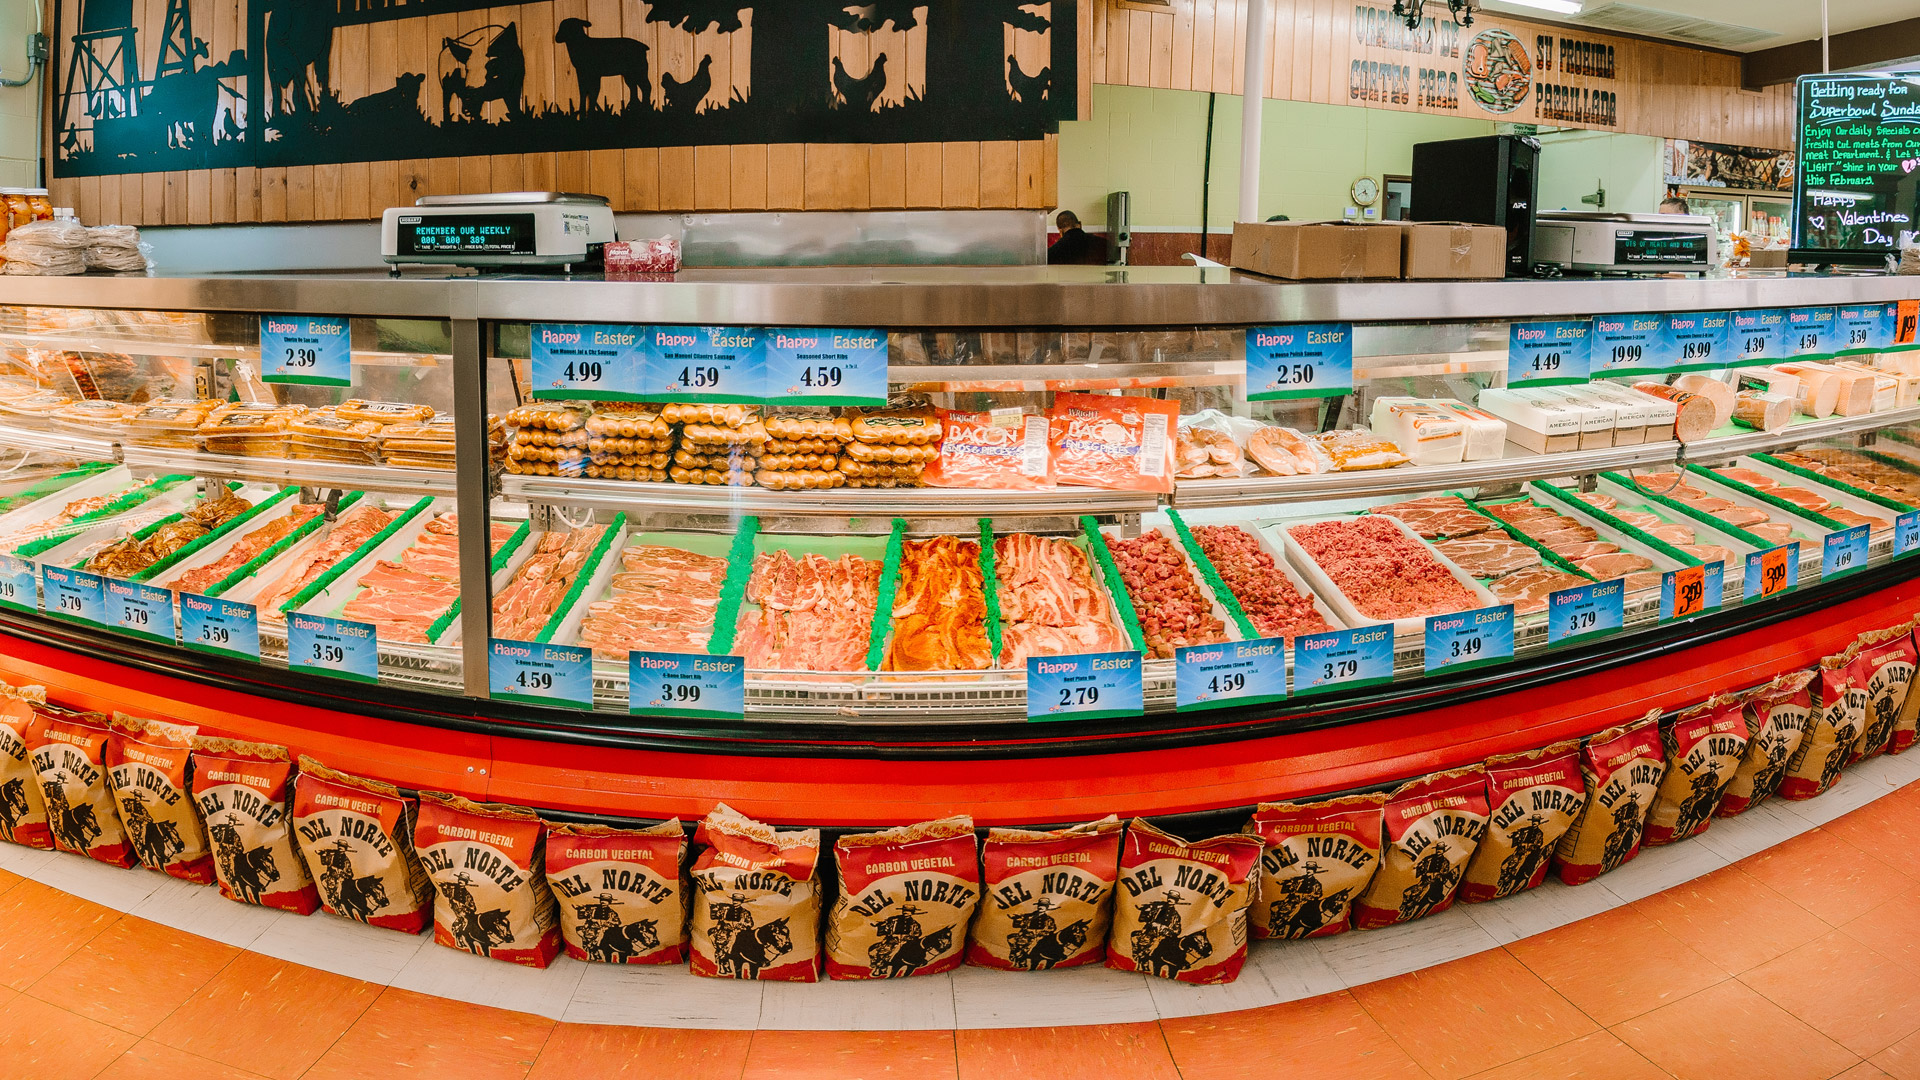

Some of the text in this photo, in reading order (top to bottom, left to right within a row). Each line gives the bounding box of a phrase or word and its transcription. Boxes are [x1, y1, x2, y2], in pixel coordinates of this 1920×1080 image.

[1536, 35, 1553, 71] SU
[1350, 59, 1458, 109] CORTES PARA
[1811, 82, 1854, 100] Getting
[1857, 83, 1886, 98] ready
[1535, 83, 1616, 126] PARRILLADA
[1805, 123, 1831, 139] Enjoy
[1848, 123, 1872, 137] daily
[1805, 137, 1834, 149] freshly
[1853, 139, 1880, 148] meats
[1881, 138, 1902, 148] from
[1805, 150, 1829, 160] meat
[1896, 150, 1911, 158] Let
[1867, 162, 1876, 171] in
[1805, 174, 1826, 185] this
[1814, 190, 1855, 208] Happy
[1836, 210, 1909, 226] Valentines
[416, 226, 511, 235] REMEMBER OUR WEEKLY
[1863, 228, 1893, 247] Day
[268, 320, 343, 335] Happy Easter
[1599, 319, 1660, 332] Happy Easter
[1671, 317, 1726, 330] Happy Easter
[542, 330, 635, 346] Happy Easter
[656, 332, 755, 348] Happy Easter
[776, 335, 879, 350] Happy Easter
[1256, 331, 1345, 347] Happy Easter
[1518, 327, 1587, 340] Happy Easter
[1799, 334, 1817, 349] 4.59
[1850, 329, 1867, 344] 3.59
[1611, 344, 1642, 363] 19.99
[1683, 341, 1711, 359] 18.99
[1745, 337, 1765, 353] 4.39
[285, 348, 316, 367] 2.39
[1532, 352, 1561, 371] 4.49
[563, 361, 602, 382] 4.99
[678, 366, 719, 387] 4.59
[800, 366, 842, 387] 4.59
[1277, 364, 1314, 384] 2.50
[949, 425, 1018, 445] BACON
[1068, 421, 1137, 443] BACON
[1835, 551, 1852, 567] 4.69
[109, 582, 133, 596] Happy
[140, 589, 168, 603] Easter
[1556, 584, 1619, 606] Happy Easter
[60, 594, 82, 611] 5.79
[187, 597, 213, 612] Happy
[221, 604, 251, 619] Easter
[124, 606, 148, 625] 5.79
[1433, 610, 1508, 632] Happy Easter
[1570, 611, 1596, 631] 3.79
[203, 624, 229, 644] 5.59
[294, 617, 370, 639] Happy Easter
[1304, 629, 1387, 651] Happy Easter
[1451, 637, 1482, 658] 3.49
[313, 643, 343, 663] 3.59
[494, 643, 584, 663] Happy Easter
[1185, 644, 1276, 664] Happy Easter
[640, 656, 736, 673] Happy Easter
[1037, 657, 1134, 675] Happy Easter
[1324, 659, 1358, 679] 3.79
[515, 670, 553, 690] 4.59
[1208, 672, 1246, 693] 4.59
[661, 683, 701, 702] 3.99
[1059, 686, 1099, 706] 2.79
[207, 770, 270, 788] CARBON VEGETAL
[1503, 770, 1566, 790] CARBON VEGETAL
[1493, 789, 1583, 830] DEL NORTE
[299, 816, 394, 858] DEL NORTE
[438, 824, 514, 848] CARBON VEGETAL
[1274, 821, 1357, 834] CARBON VEGETAL
[566, 848, 654, 860] CARBON VEGETAL
[1148, 841, 1230, 865] CARBON VEGETAL
[1261, 837, 1374, 875] DEL NORTE
[421, 847, 524, 893] DEL NORTE
[865, 857, 956, 875] CARBON VEGETAL
[1121, 865, 1235, 908] DEL NORTE
[850, 879, 975, 917] DEL NORTE
